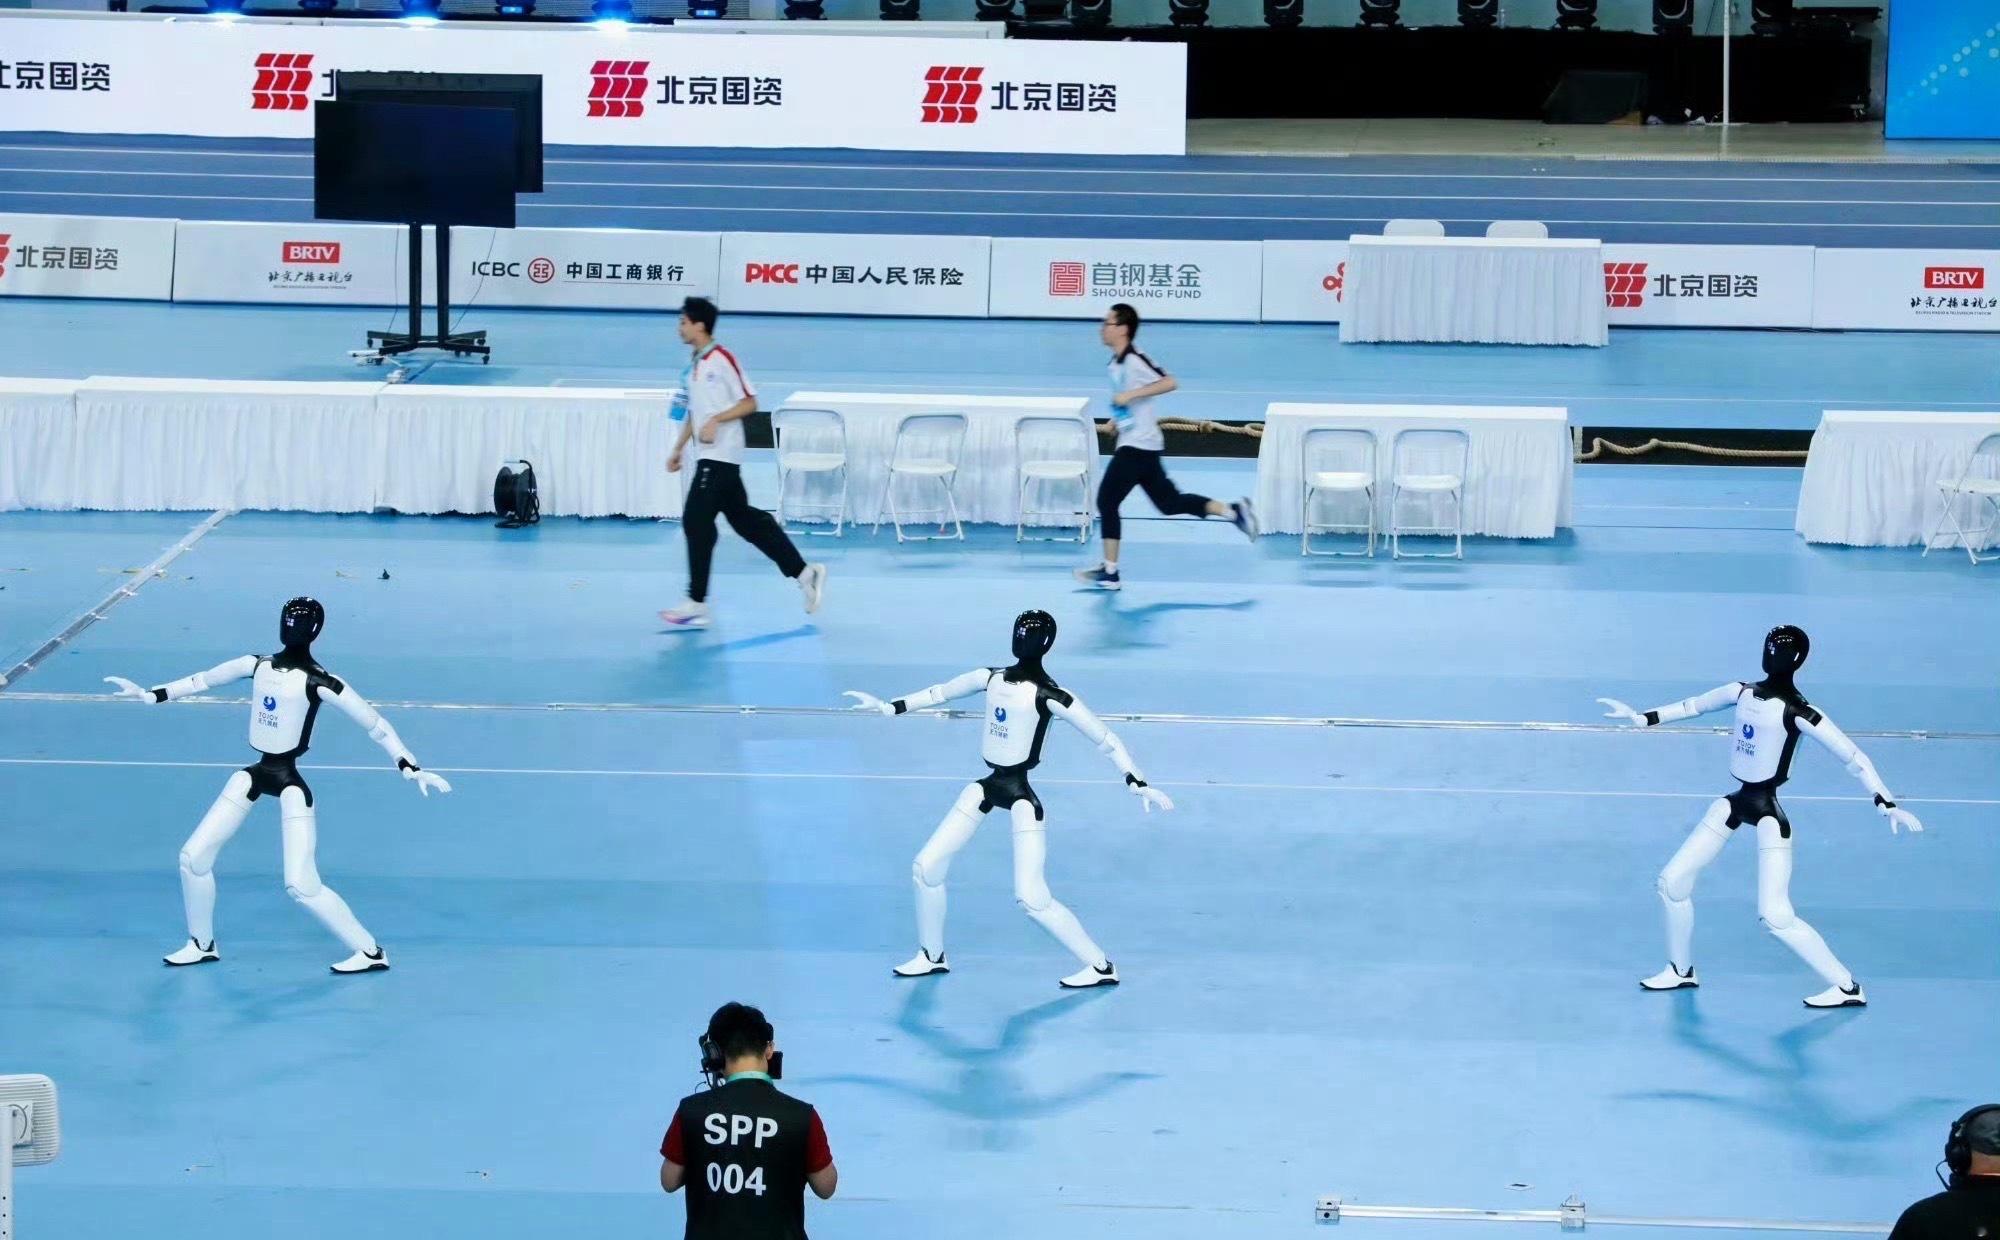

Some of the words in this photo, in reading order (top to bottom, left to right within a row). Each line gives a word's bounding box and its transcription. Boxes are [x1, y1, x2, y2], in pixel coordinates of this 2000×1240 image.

[656, 75, 782, 106] 北京国资
[990, 81, 1117, 112] 北京国资
[15, 245, 118, 270] 北京国资
[288, 245, 336, 260] BRTV
[471, 261, 521, 277] ICBC
[745, 263, 799, 284] PICC
[805, 264, 964, 286] 中国人民保险
[1091, 262, 1201, 288] 首钢基金
[1931, 271, 1979, 286] BRTV
[1091, 288, 1163, 298] SHOUGANG
[1167, 289, 1201, 299] FUND
[1653, 274, 1758, 298] 北京国资
[703, 1112, 779, 1149] SPP
[706, 1161, 767, 1196] 004
